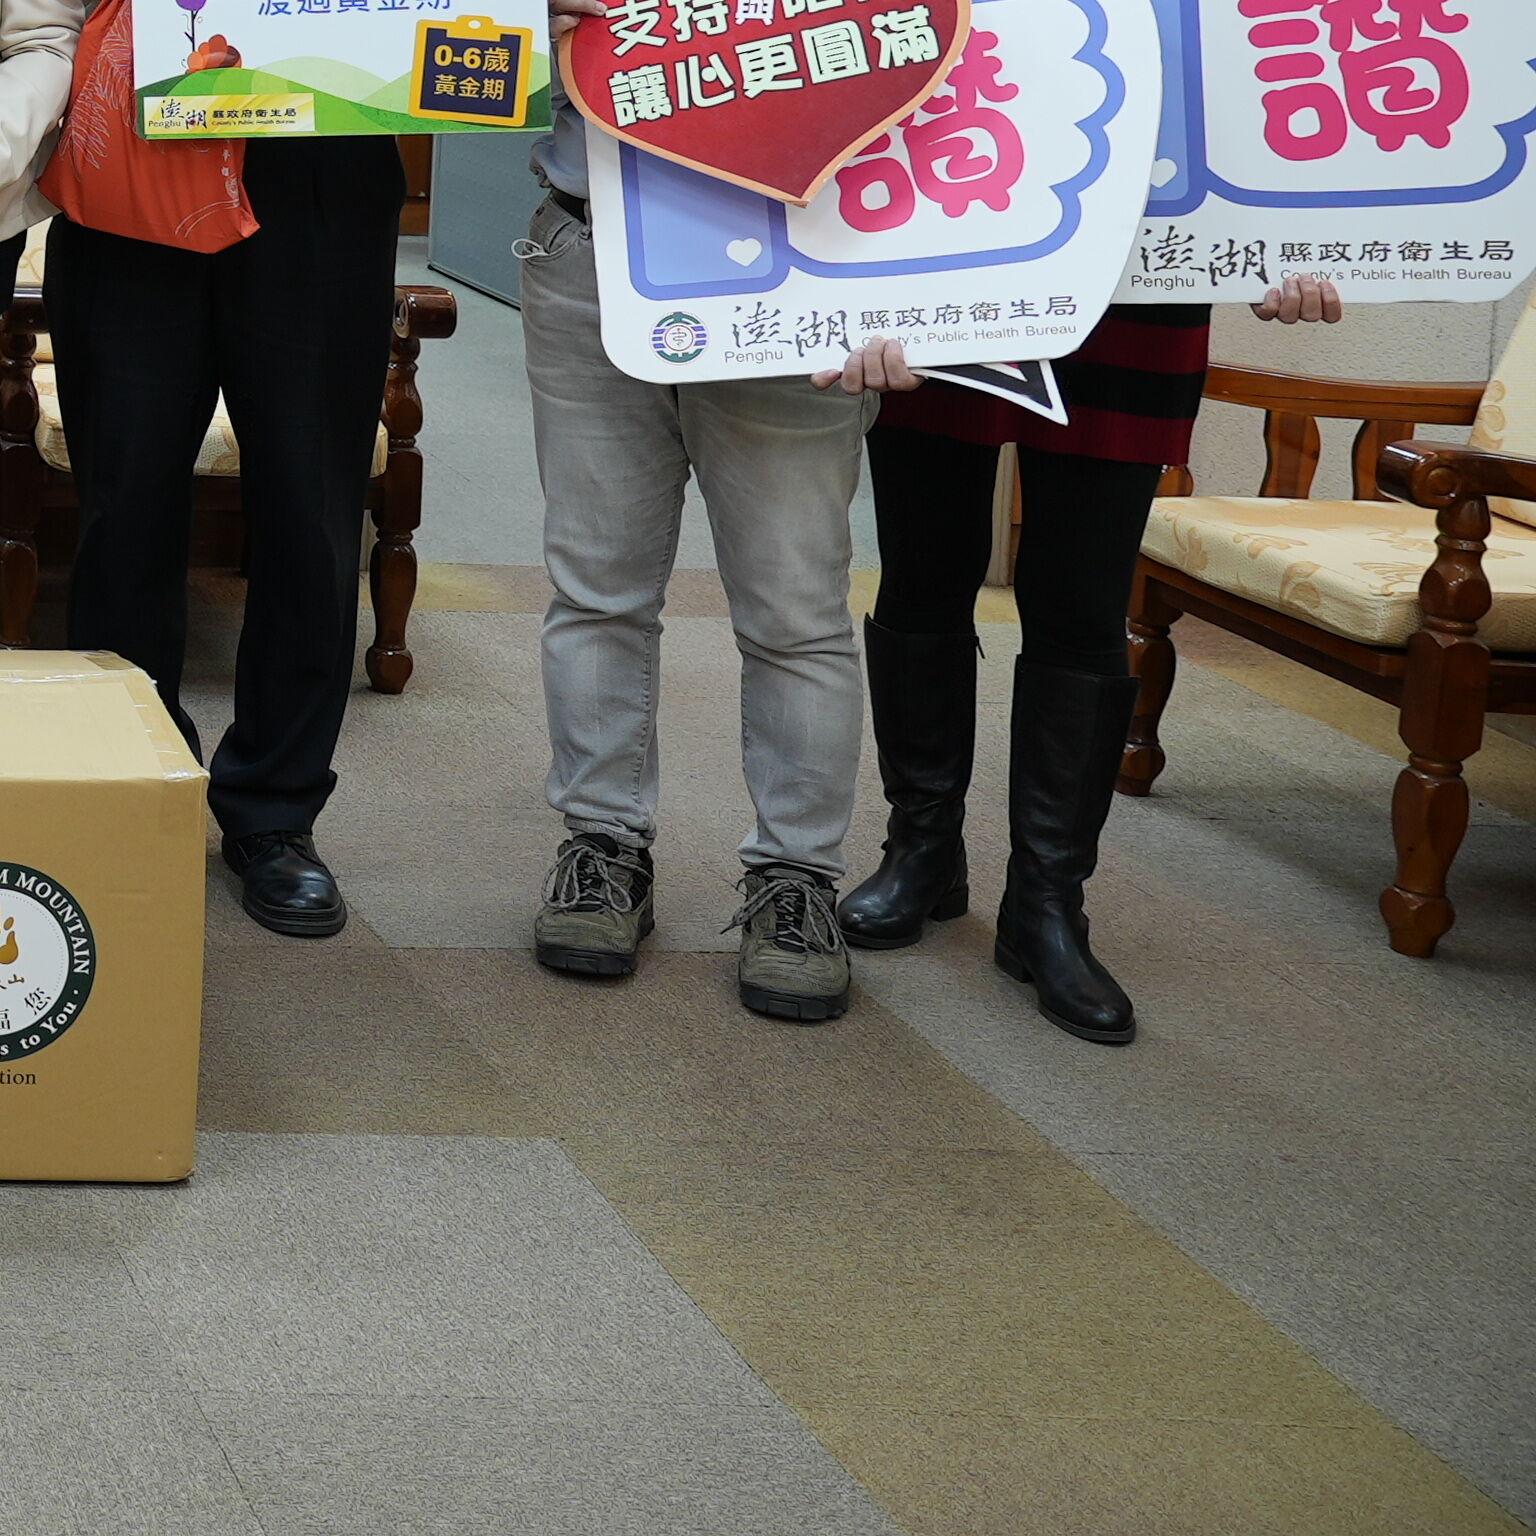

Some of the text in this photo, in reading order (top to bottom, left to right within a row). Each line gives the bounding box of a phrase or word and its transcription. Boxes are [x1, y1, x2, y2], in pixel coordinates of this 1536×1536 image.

[434, 44, 511, 74] 0-6歲
[608, 4, 941, 128] 讓心更圓滿
[434, 73, 505, 101] 黃金期
[148, 120, 181, 129] Penghu
[1131, 275, 1195, 291] Penghu
[1351, 267, 1396, 280] Public
[1402, 267, 1450, 280] Health
[1456, 267, 1512, 280] Bureau
[724, 347, 784, 365] Penghu
[926, 330, 969, 345] Public
[973, 326, 1020, 341] Health
[1025, 322, 1078, 337] Bureau
[15, 871, 90, 975] MOUNTAIN
[19, 1034, 41, 1050] to
[39, 1002, 78, 1035] You
